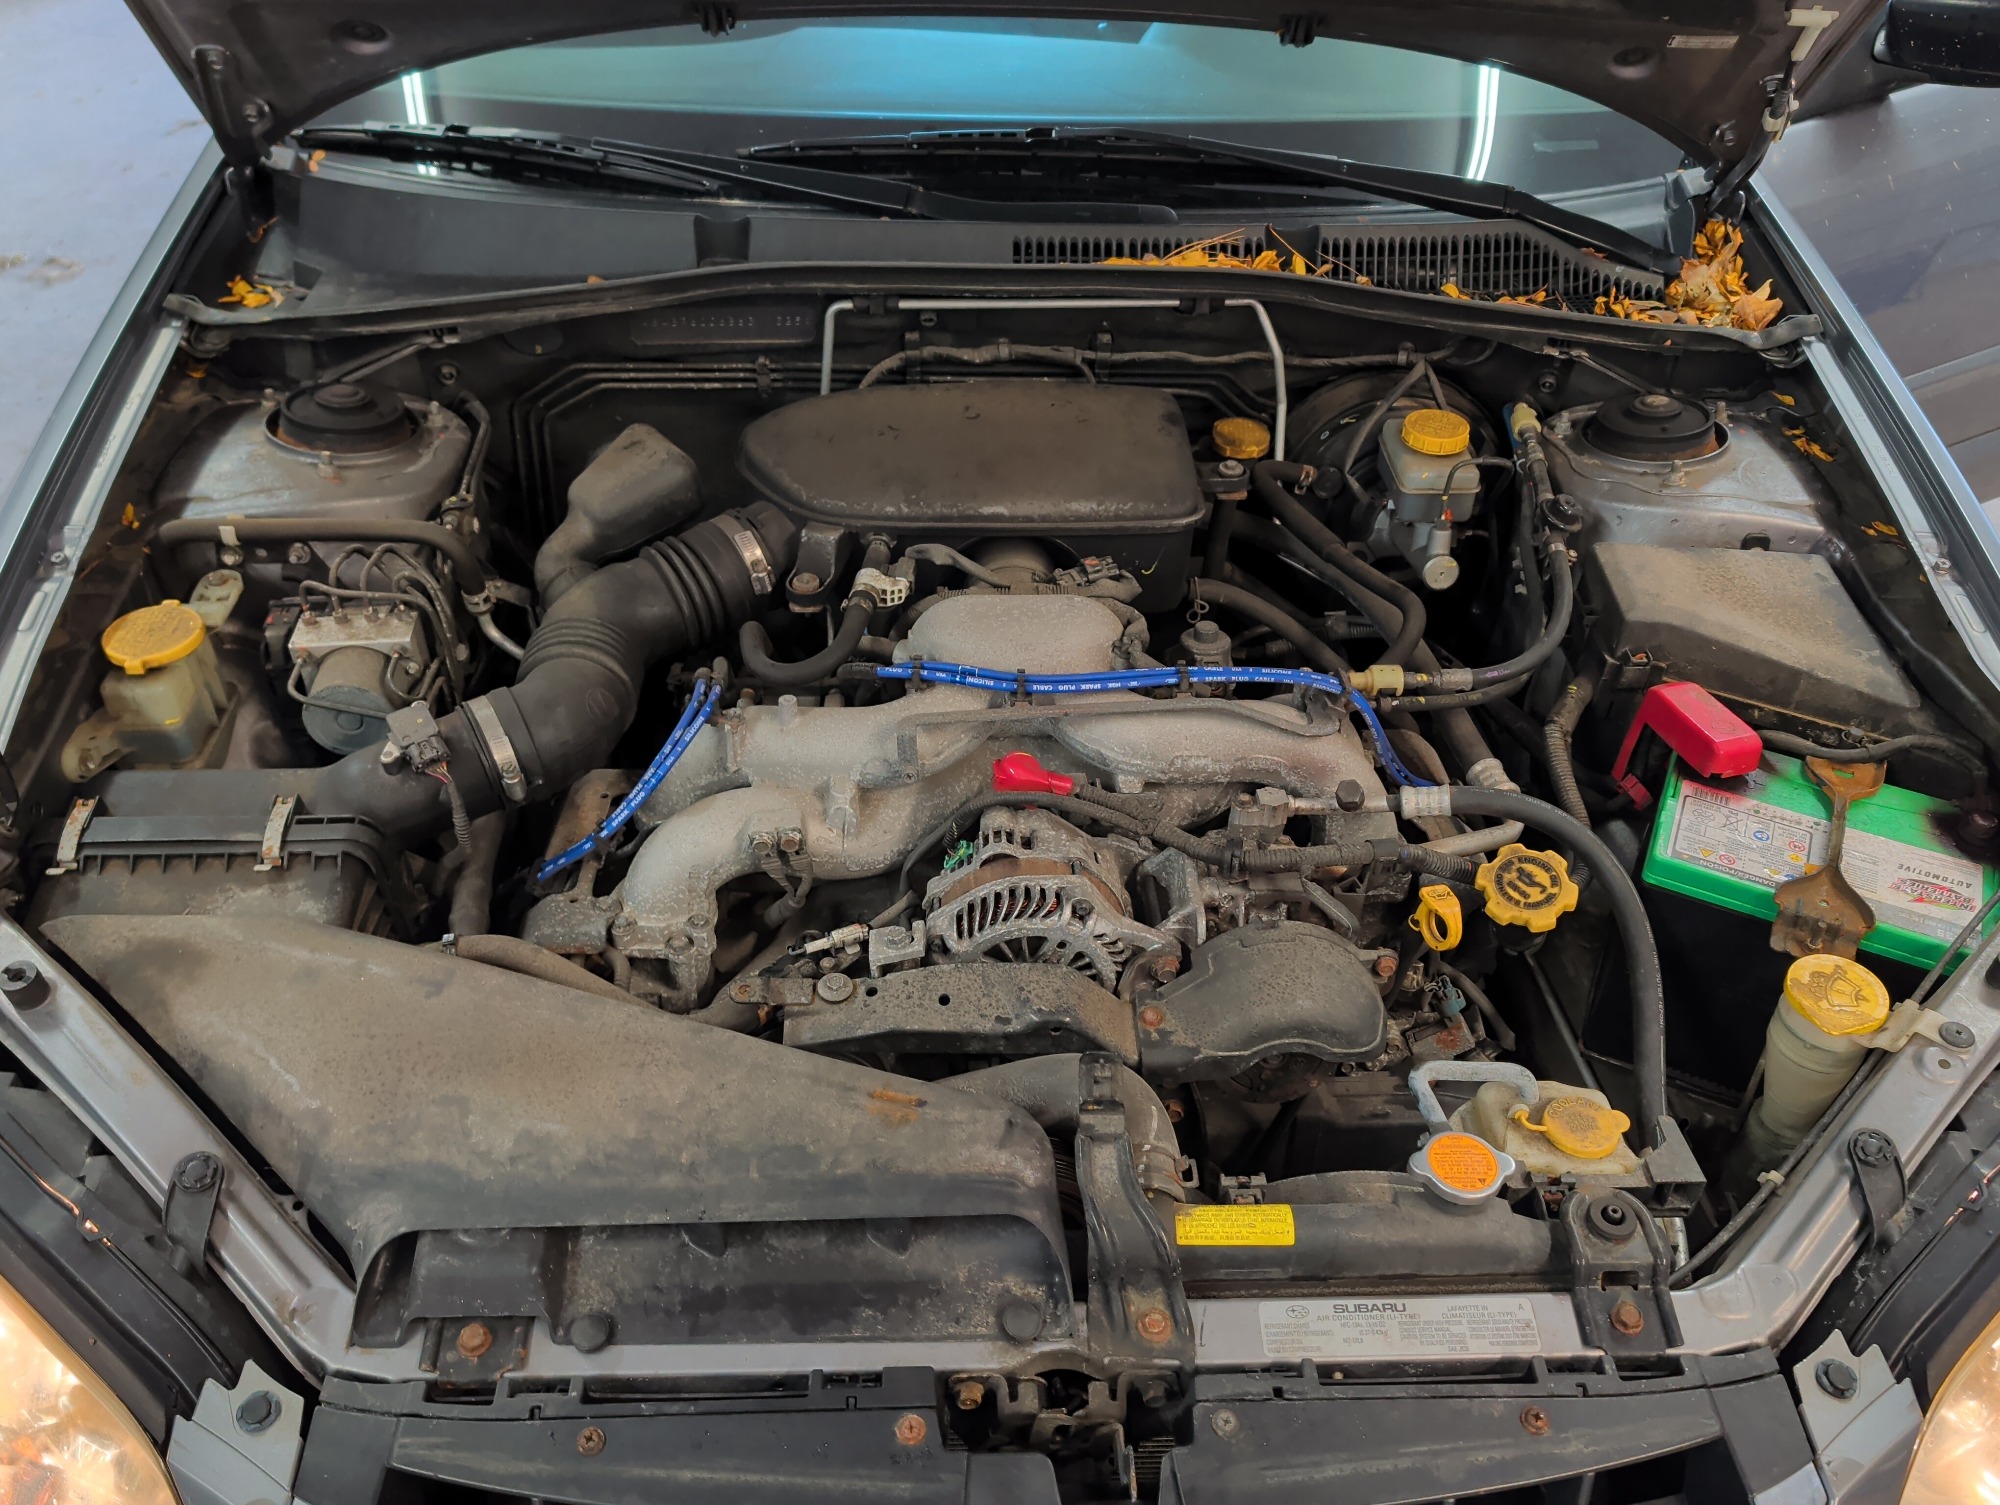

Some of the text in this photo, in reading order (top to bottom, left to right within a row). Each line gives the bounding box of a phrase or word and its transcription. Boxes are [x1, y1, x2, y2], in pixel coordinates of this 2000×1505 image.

[1261, 668, 1293, 676] SILICONE
[611, 809, 630, 828] SPARK
[630, 791, 646, 808] PLUG
[684, 715, 706, 742] SILICONE
[1517, 857, 1559, 889] ENGINE OIL
[1699, 859, 1776, 888] DANGER/POISON
[1896, 863, 1973, 889] AUTOMOTIVE
[1523, 892, 1557, 909] MANUAL
[1888, 882, 1976, 912] INTERSTATE
[1896, 877, 1973, 904] BATTERIES
[1332, 1313, 1385, 1322] CONDITIONER
[1333, 1303, 1407, 1314] SUBARU
